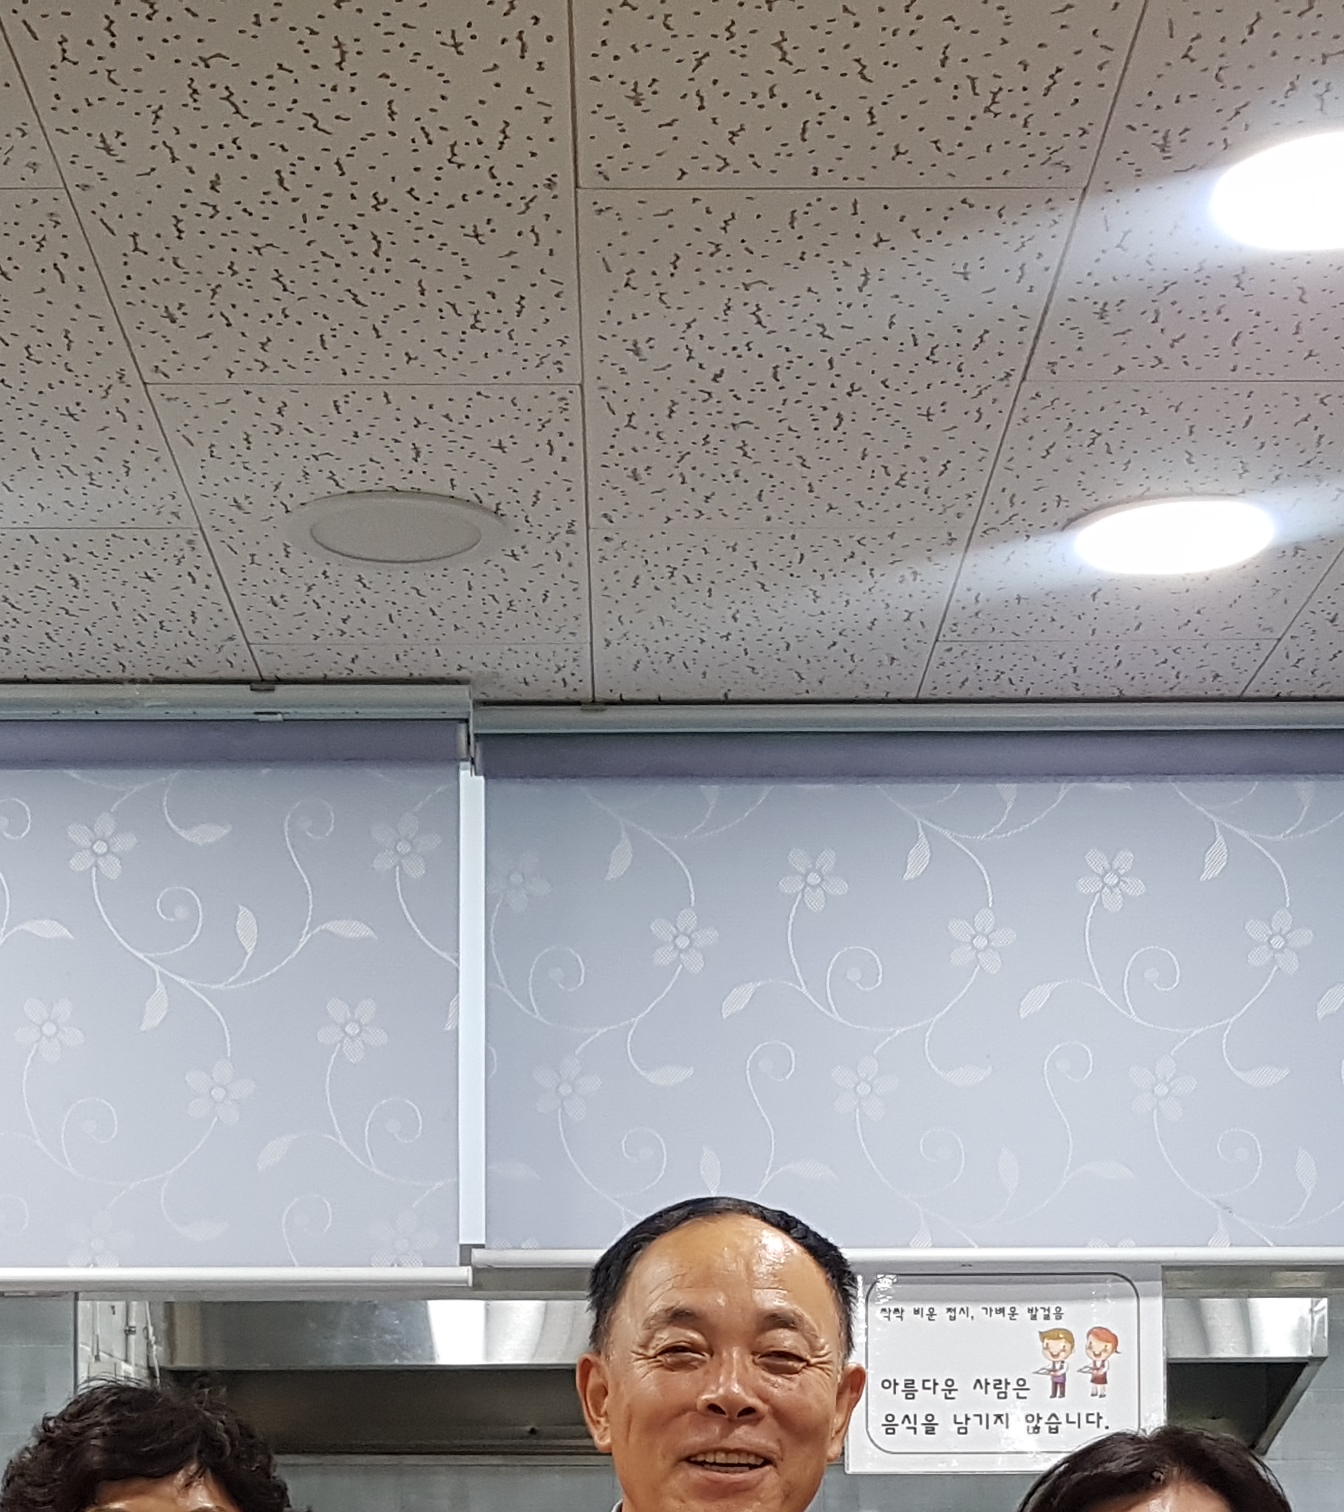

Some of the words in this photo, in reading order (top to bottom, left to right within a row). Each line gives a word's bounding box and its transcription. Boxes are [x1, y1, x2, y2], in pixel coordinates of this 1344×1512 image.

[914, 1307, 937, 1321] 비운
[946, 1307, 974, 1321] 접시,
[982, 1307, 1018, 1320] 가벼운
[1028, 1306, 1064, 1320] 발걸음
[881, 1378, 958, 1400] 아름다운
[973, 1378, 1030, 1399] 사람은
[882, 1414, 938, 1435] 음식을
[954, 1413, 1008, 1435] 남기지
[1024, 1412, 1110, 1434] 않습니다.
